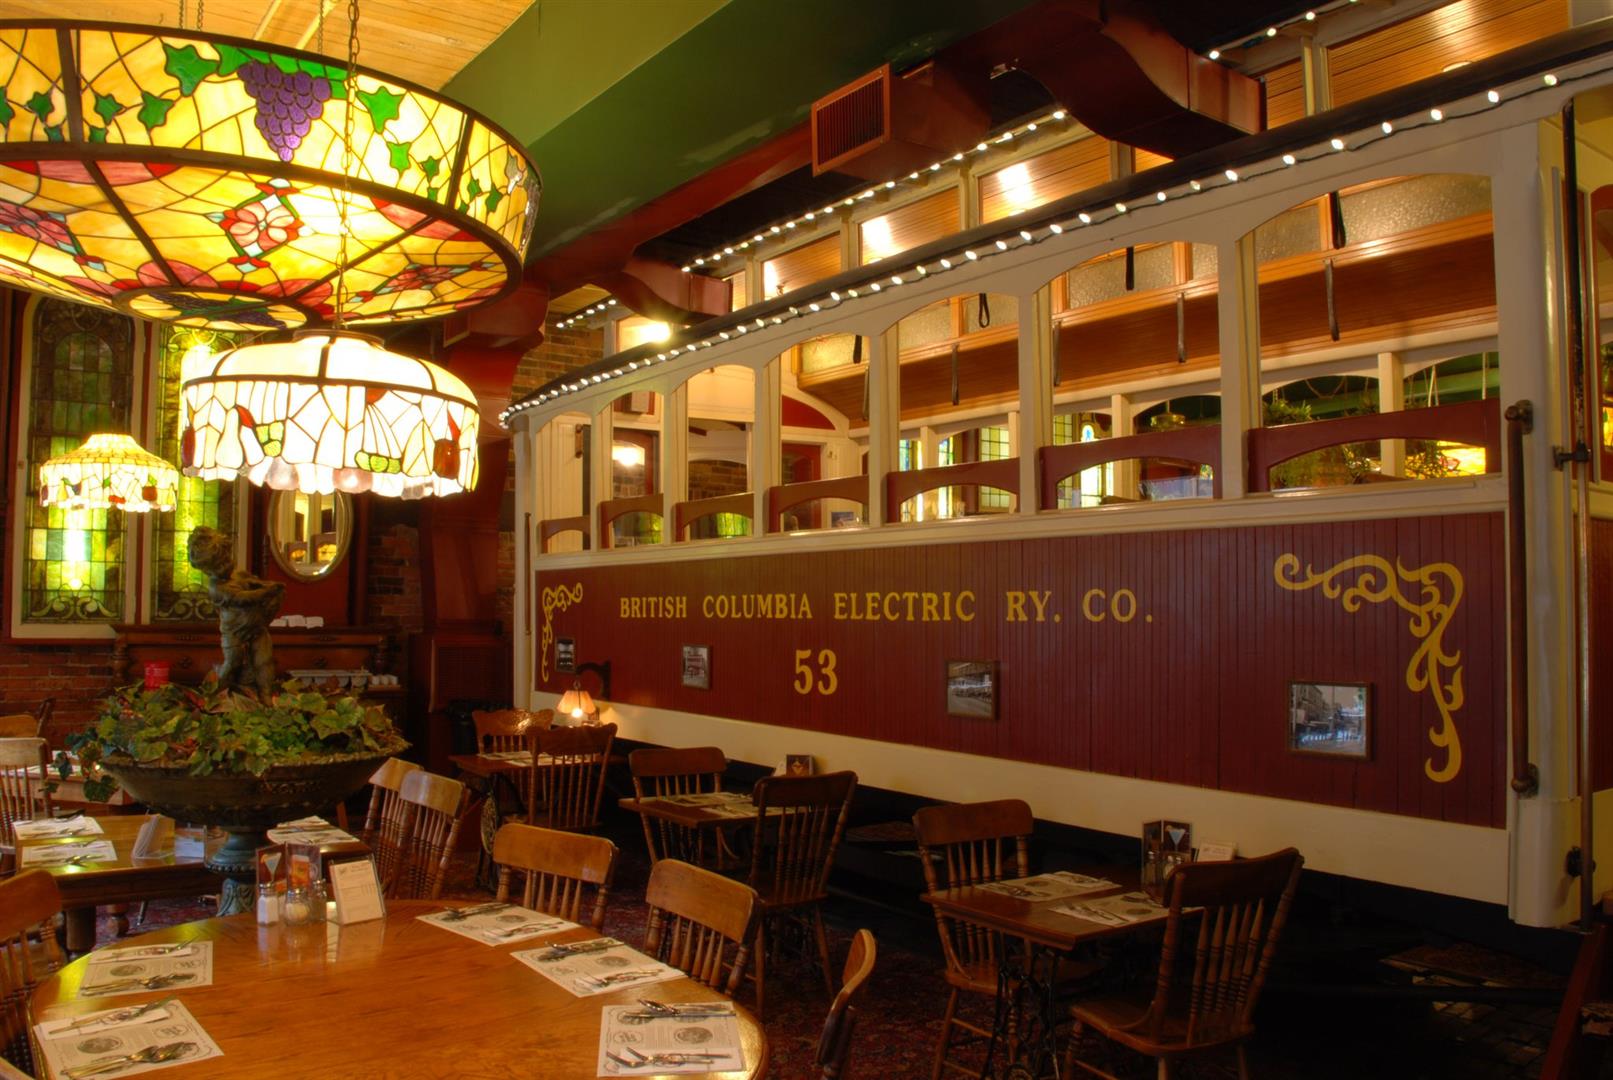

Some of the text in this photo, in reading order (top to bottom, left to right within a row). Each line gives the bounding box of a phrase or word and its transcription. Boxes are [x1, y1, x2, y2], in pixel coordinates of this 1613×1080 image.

[620, 588, 1153, 623] BRITISH COLUMBIA ELECTRIC RY. CO.
[793, 649, 838, 695] 53
